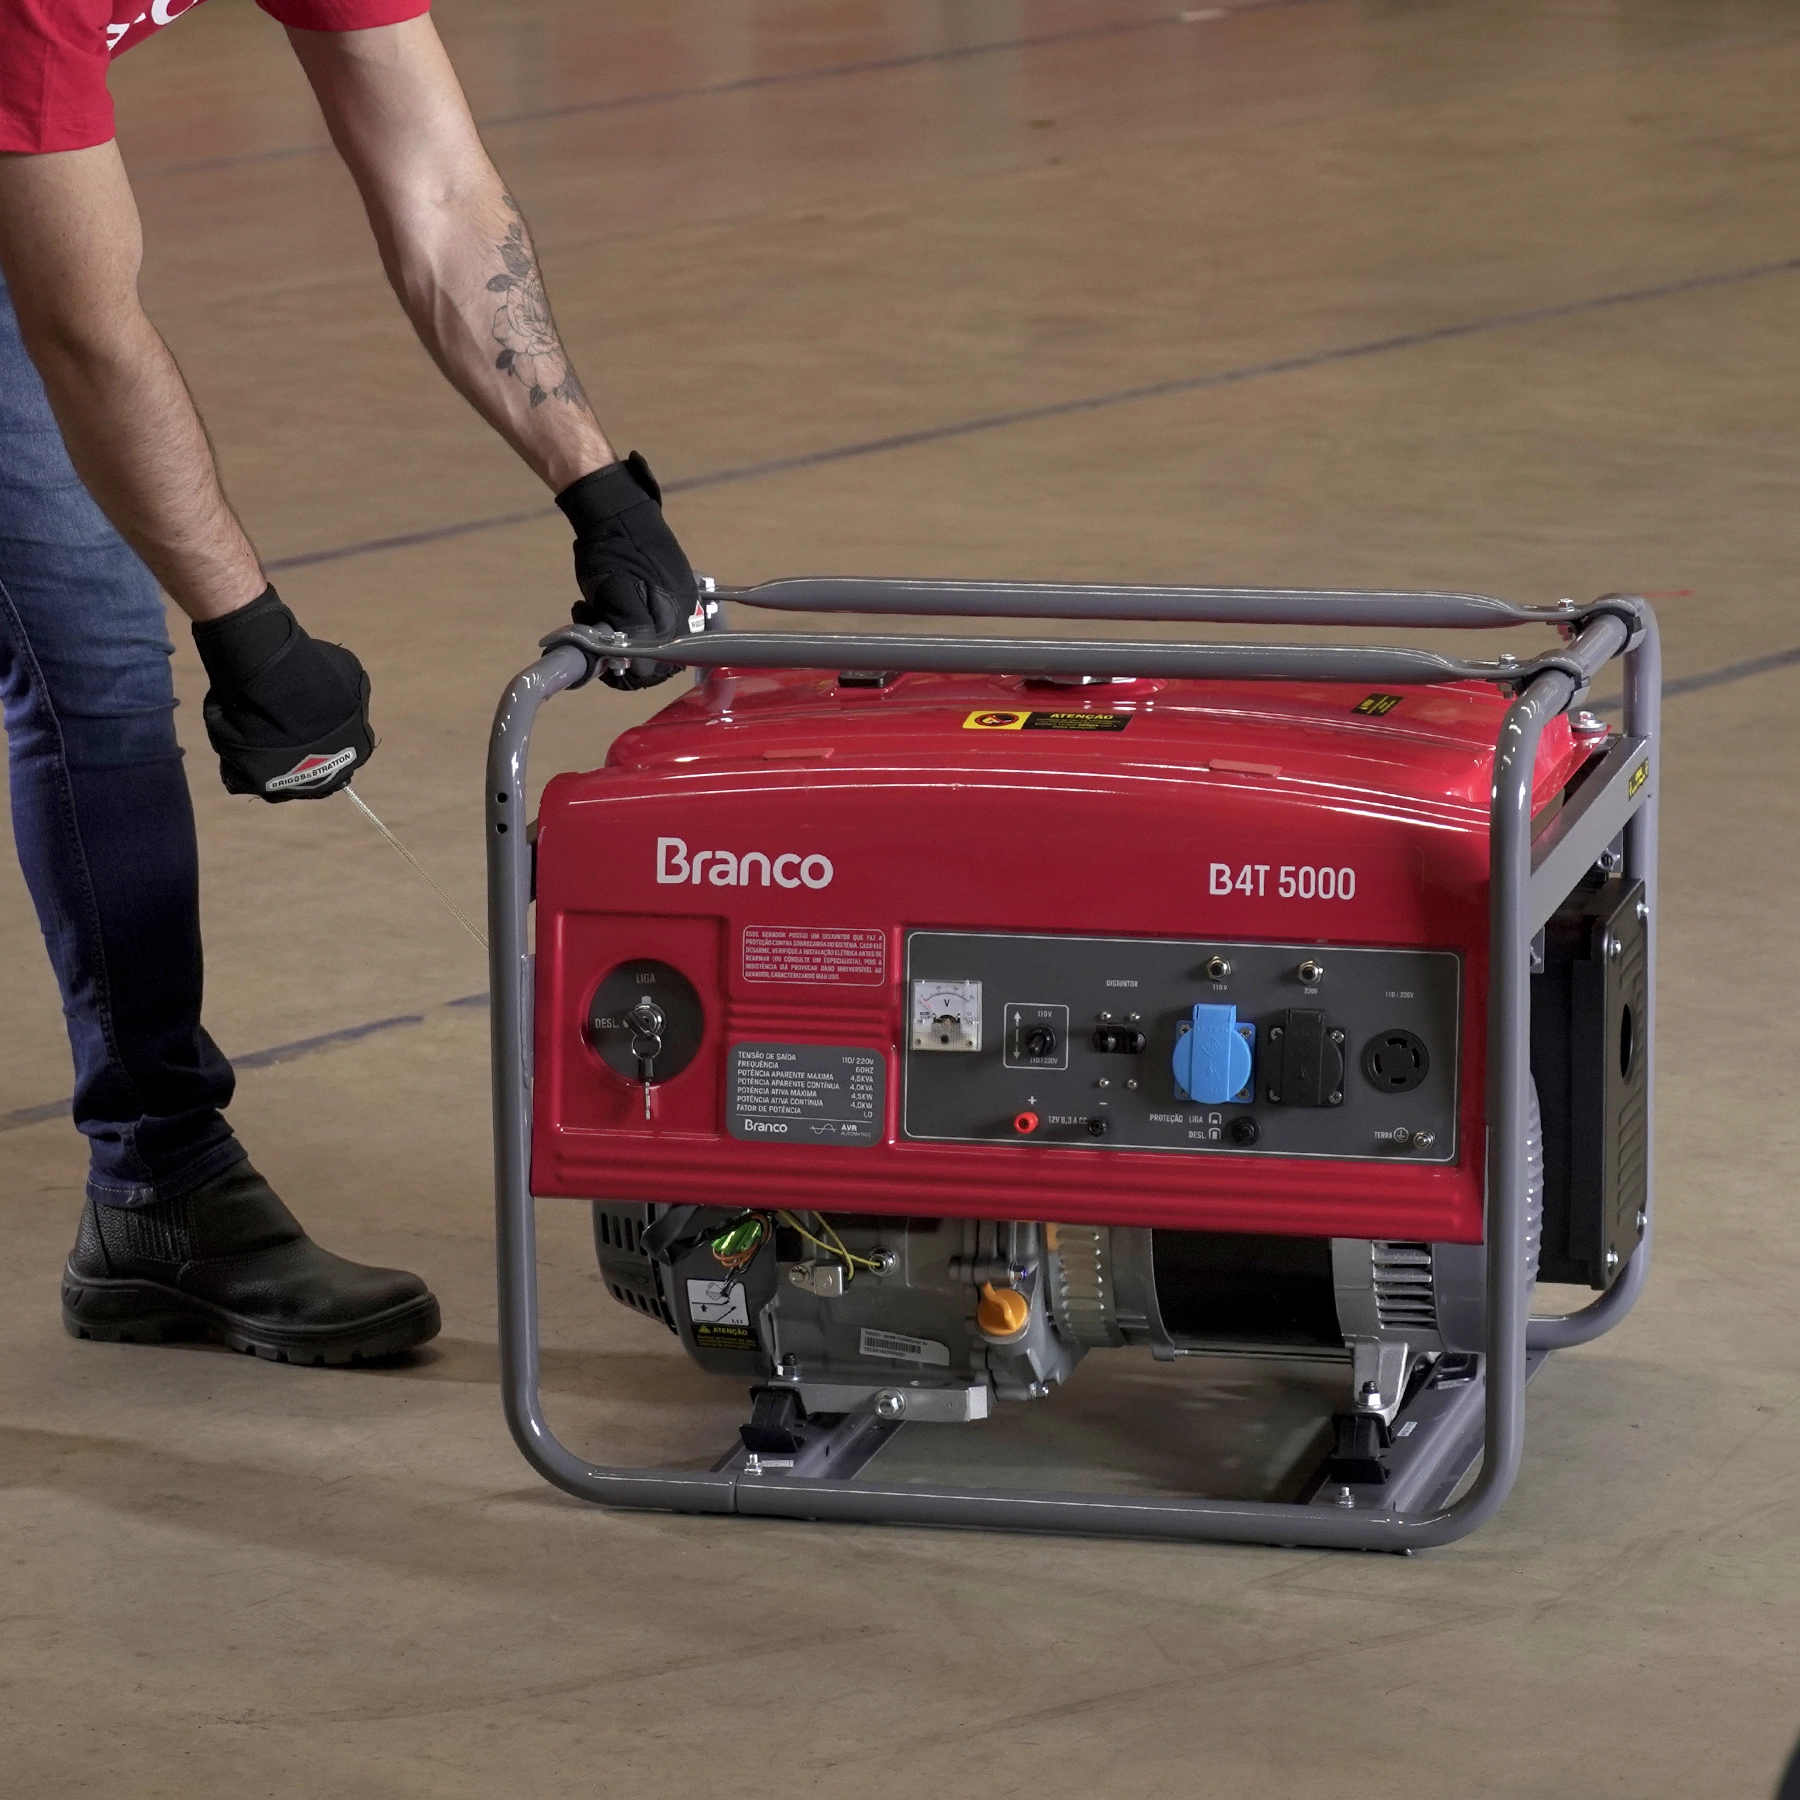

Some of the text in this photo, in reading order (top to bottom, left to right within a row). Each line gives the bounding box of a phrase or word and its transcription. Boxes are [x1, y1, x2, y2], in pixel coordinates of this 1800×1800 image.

[1050, 712, 1114, 720] ATENÇÃO
[656, 836, 834, 889] Branco
[1209, 863, 1356, 900] B4T 5000
[746, 938, 773, 946] PROTEÇÃO
[803, 948, 834, 956] INSTALAÇÃO
[745, 962, 777, 970] INSISTÊNCIA
[636, 973, 656, 984] LIGA
[770, 971, 815, 979] CARACTERIZANDO
[1106, 980, 1139, 988] DISJUNTOR
[944, 999, 950, 1007] V
[594, 1018, 620, 1029] DESL.
[738, 1050, 796, 1060] TENSÃO DE SAÍDA
[738, 1060, 779, 1069] FREQUÊNCIA
[737, 1068, 834, 1080] POTÊNCIA APARENTE MÁXIMA
[855, 1066, 874, 1074] 60HZ
[737, 1077, 840, 1089] POTÊNCIA APARENTE CONTÍNUA
[737, 1086, 817, 1097] POTÊNCIA ATIVA MÁXIMA
[737, 1095, 824, 1107] POTÊNCIA ATIVA CONTÍNUA
[736, 1104, 757, 1112] FATOR
[769, 1105, 801, 1114] POTÊNCIA
[1150, 1112, 1204, 1124] PROTEÇÃO LIGA
[744, 1119, 788, 1133] Branco
[841, 1124, 858, 1132] AVR
[1188, 1131, 1207, 1139] DESL.
[1374, 1131, 1393, 1139] TERRA
